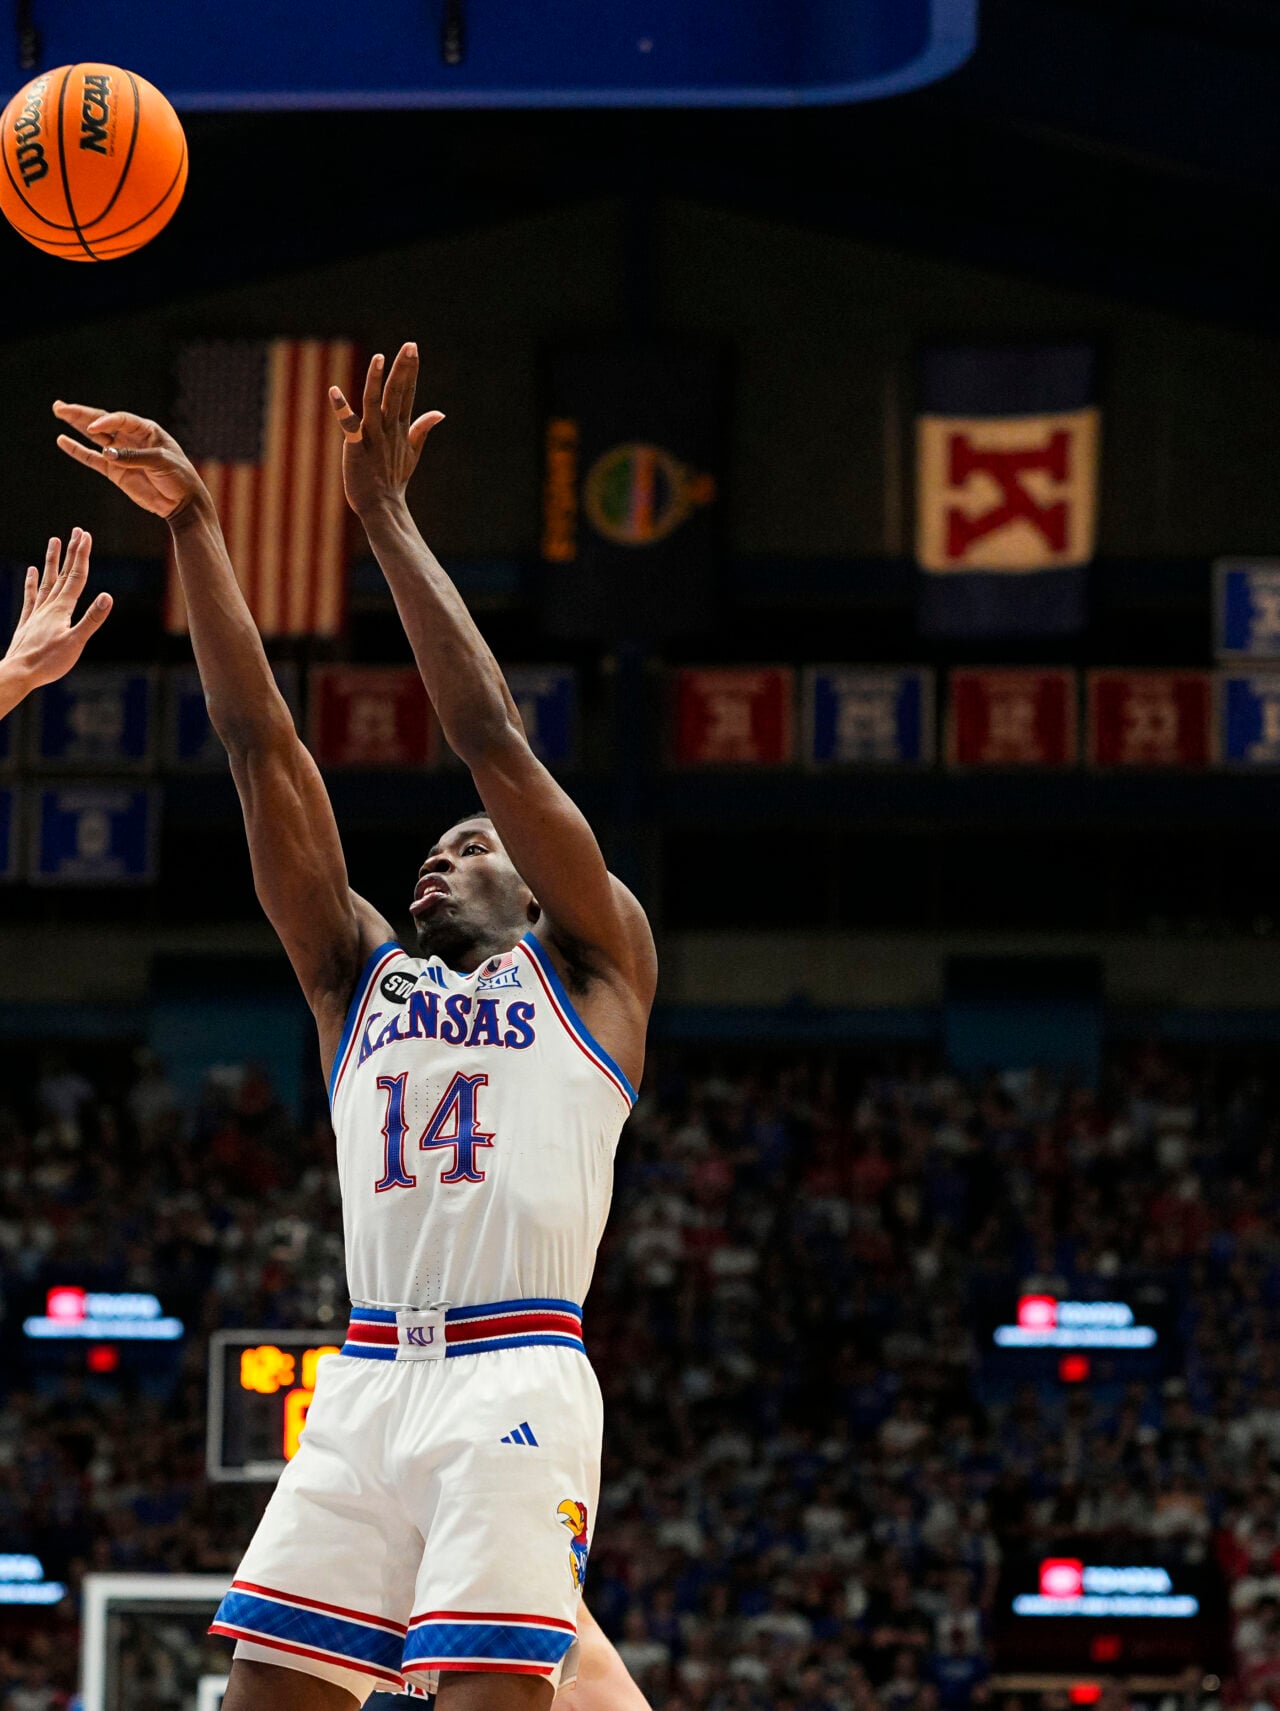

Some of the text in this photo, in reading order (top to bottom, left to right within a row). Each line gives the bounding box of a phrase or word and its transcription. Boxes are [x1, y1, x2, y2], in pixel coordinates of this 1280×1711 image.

[79, 75, 111, 155] NCAA
[946, 428, 1072, 562] K
[357, 990, 536, 1070] KANSAS
[375, 1071, 497, 1193] 14
[406, 1326, 435, 1347] KU
